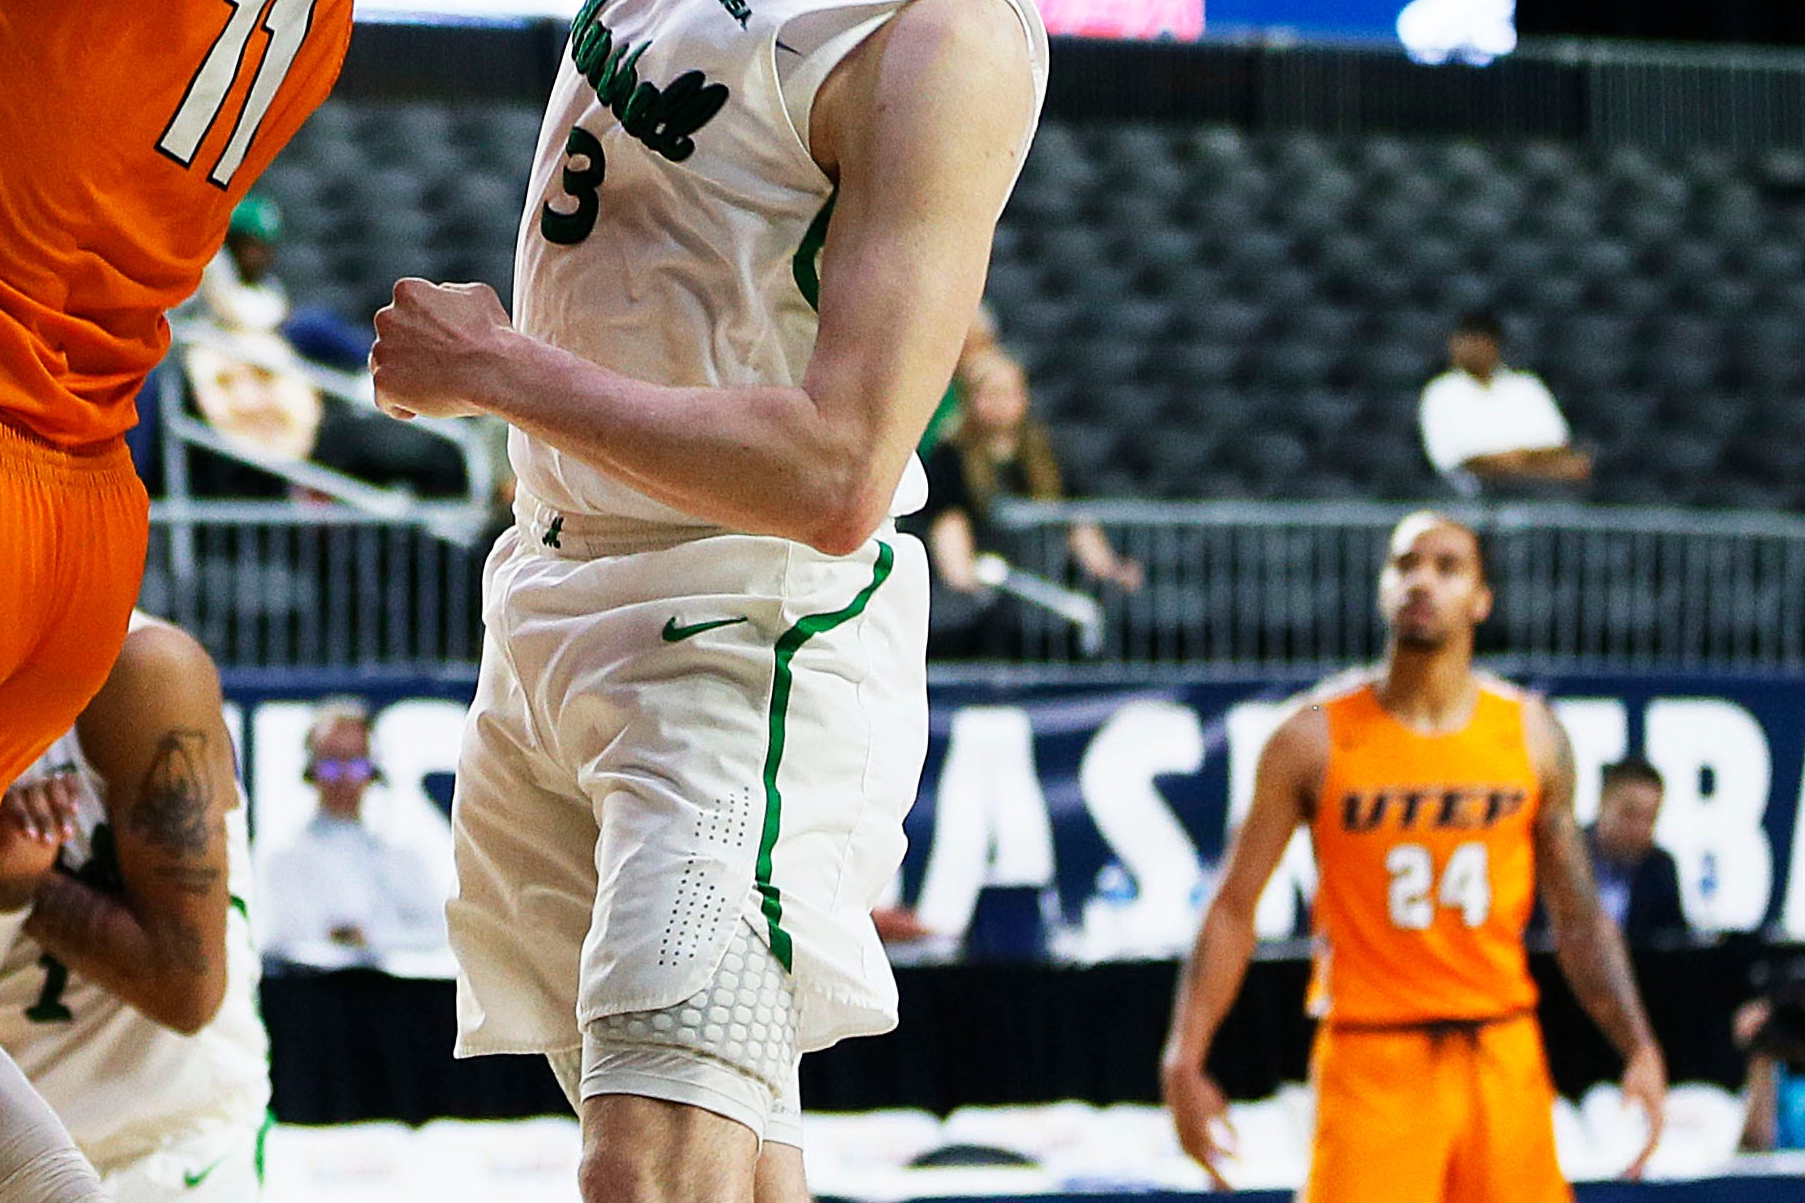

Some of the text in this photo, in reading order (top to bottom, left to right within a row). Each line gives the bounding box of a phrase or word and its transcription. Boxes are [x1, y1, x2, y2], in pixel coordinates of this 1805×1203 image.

[541, 126, 606, 245] 3
[1343, 787, 1526, 834] UTEP
[1384, 841, 1493, 928] 24
